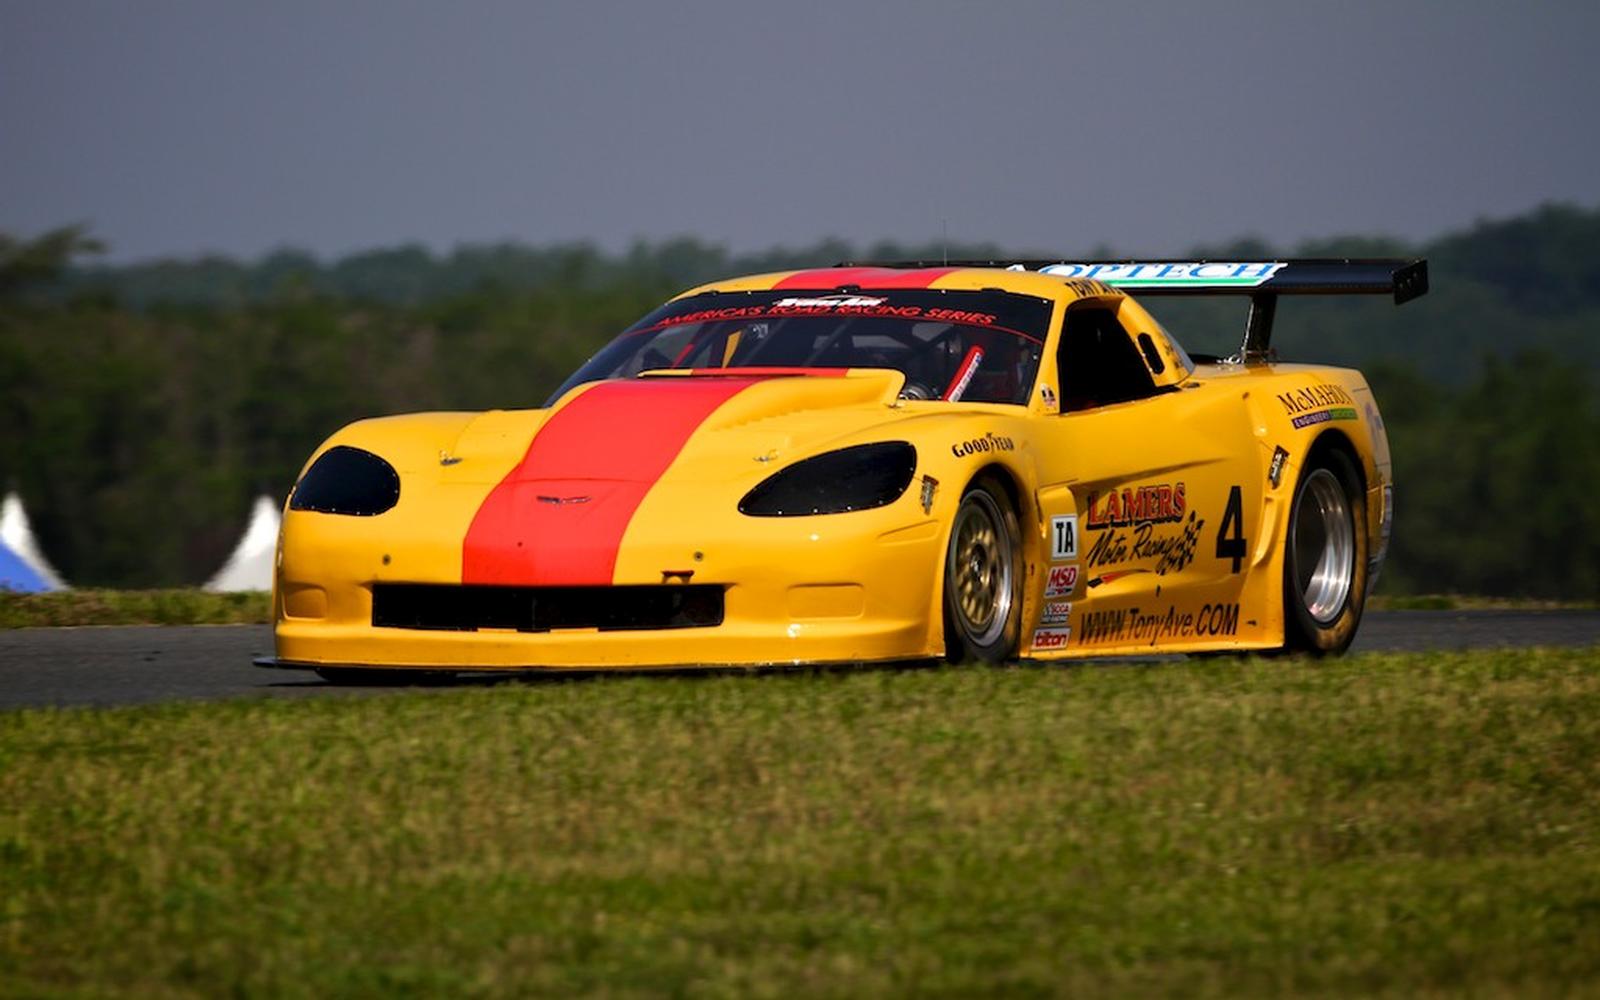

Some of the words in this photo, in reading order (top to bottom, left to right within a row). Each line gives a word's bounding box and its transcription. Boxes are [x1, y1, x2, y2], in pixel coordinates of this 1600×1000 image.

[655, 305, 766, 328] AMERICA'S
[768, 305, 831, 316] ROAD
[835, 305, 921, 316] RACING
[924, 308, 997, 325] SERIES
[1086, 483, 1186, 530] LAMERS
[1056, 521, 1073, 553] TA
[1086, 529, 1127, 569] Motor
[1216, 486, 1247, 574] 4
[1049, 567, 1076, 587] MSD
[1079, 604, 1239, 646] WWW.TonyAve.COM
